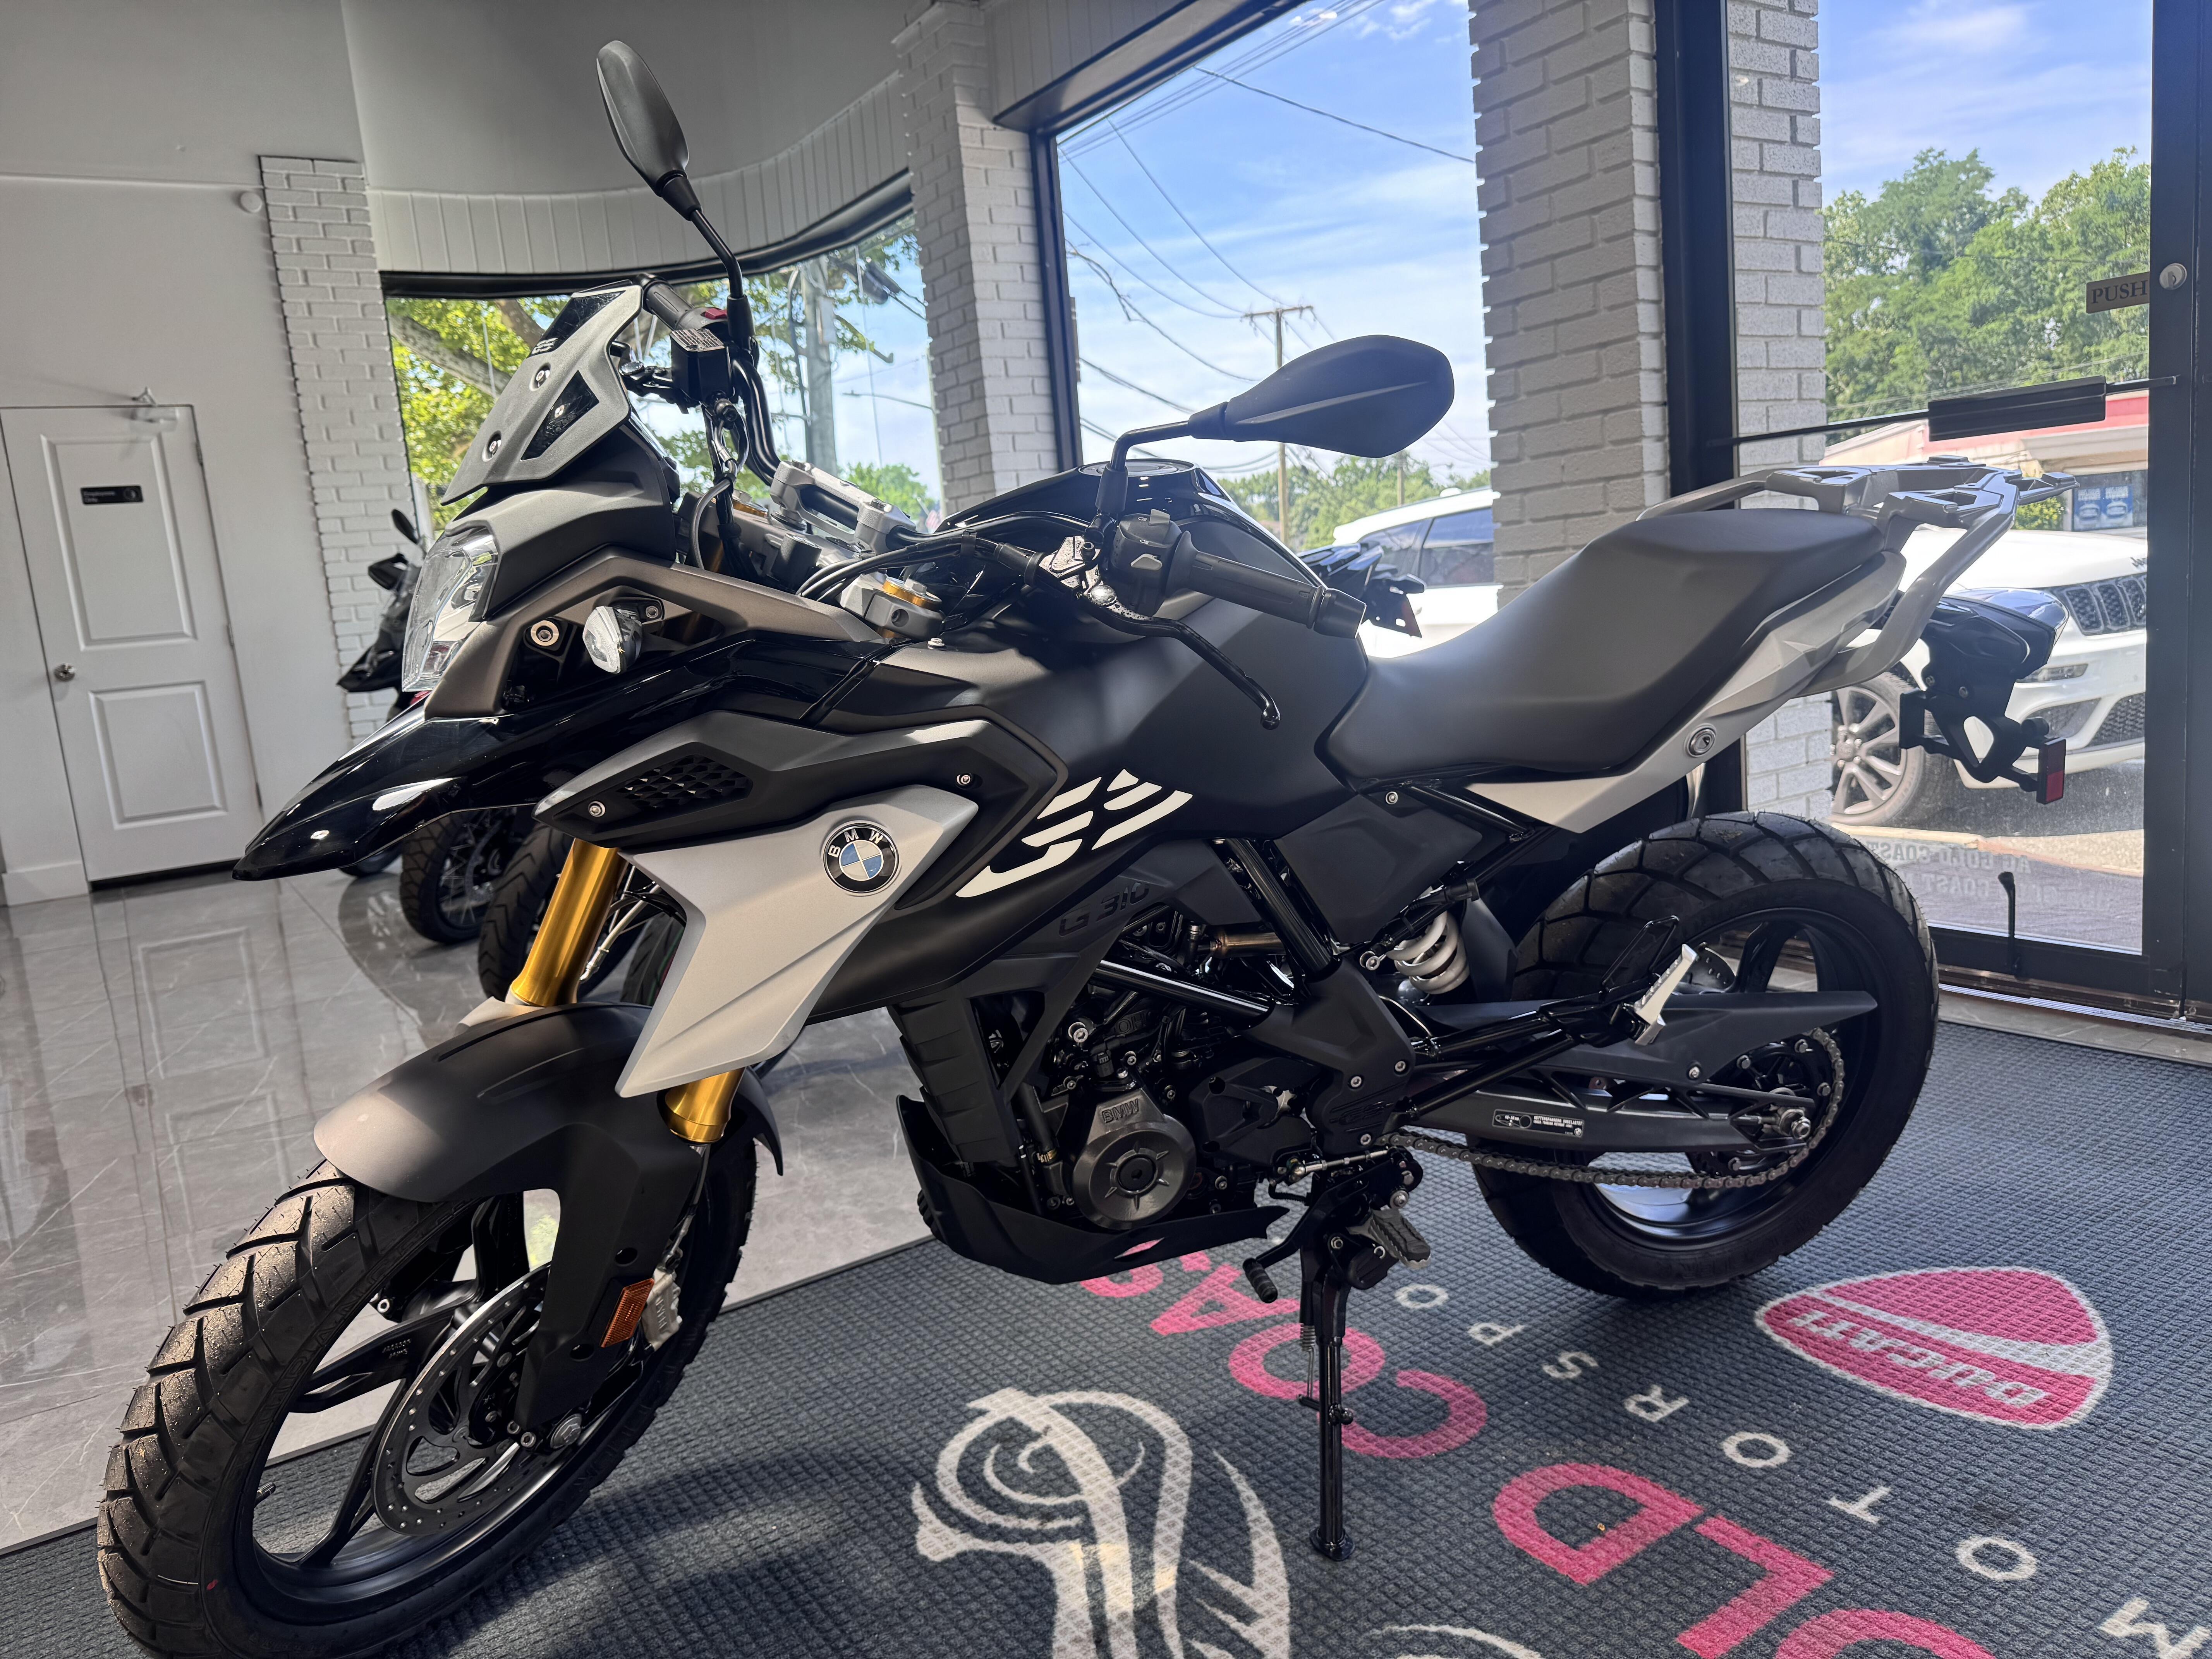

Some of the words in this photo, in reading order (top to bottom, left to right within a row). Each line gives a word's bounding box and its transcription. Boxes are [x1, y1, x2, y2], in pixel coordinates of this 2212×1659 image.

[2091, 280, 2148, 304] PUSH
[828, 829, 884, 858] BMW
[1059, 904, 1091, 937] G
[1096, 882, 1149, 922] 310
[1102, 1097, 1139, 1124] BMW
[1786, 1309, 2046, 1408] DUCATI
